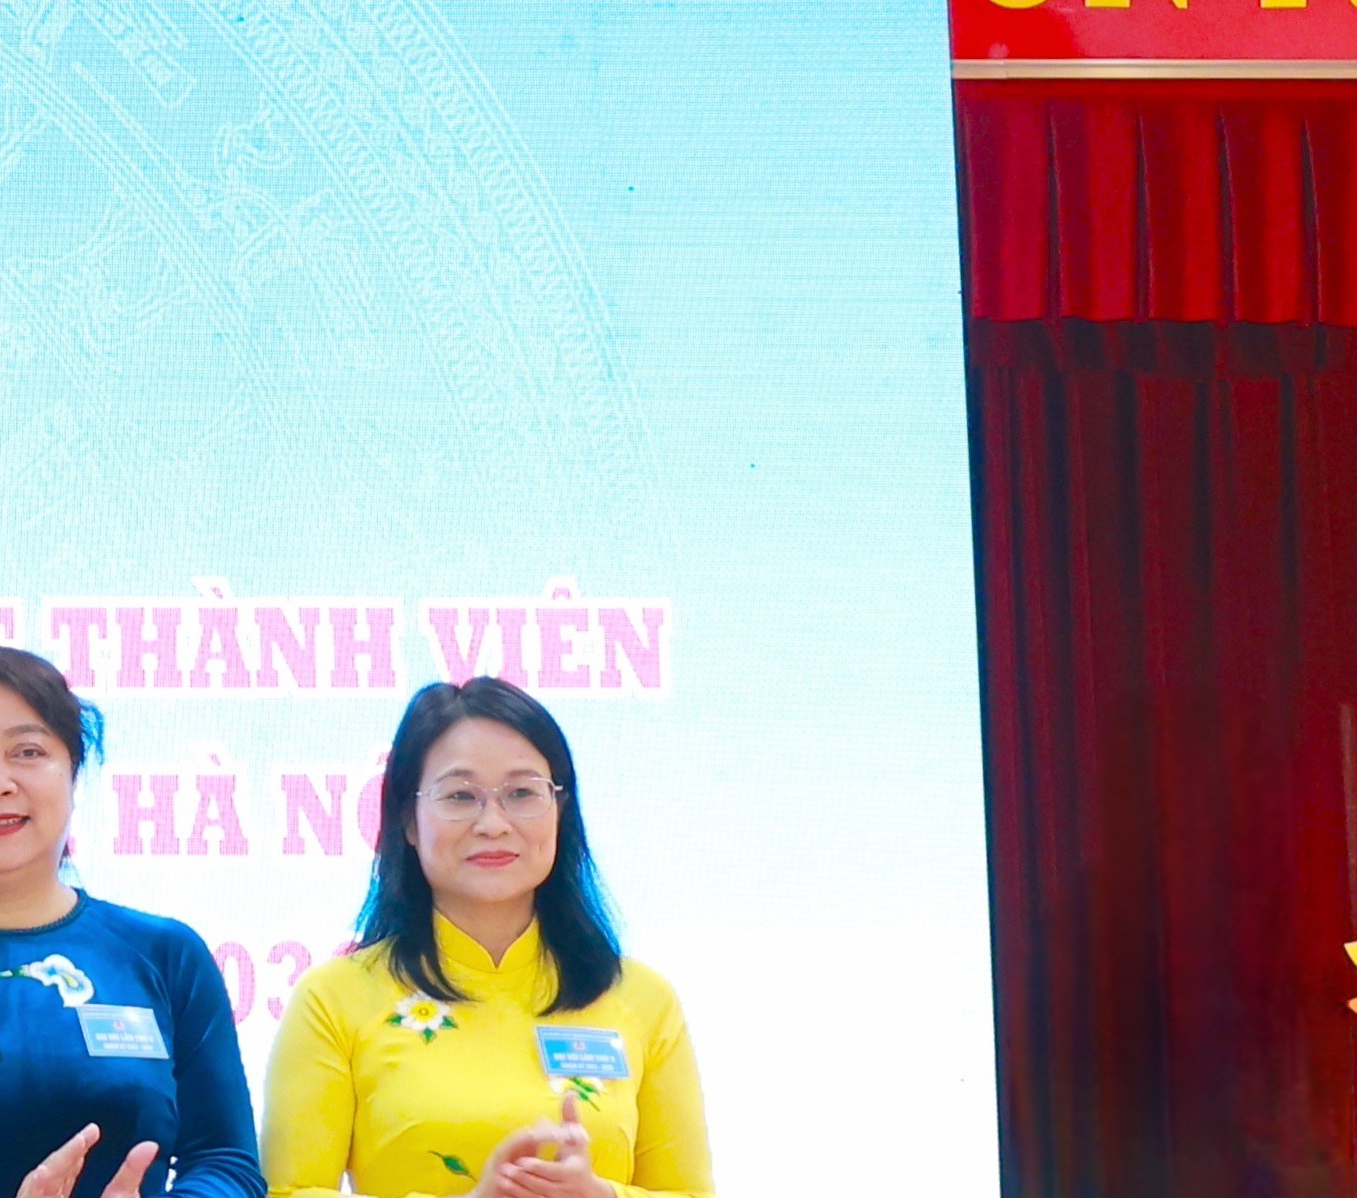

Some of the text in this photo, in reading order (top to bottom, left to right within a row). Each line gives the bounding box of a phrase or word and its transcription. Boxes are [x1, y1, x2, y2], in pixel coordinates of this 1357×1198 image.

[50, 586, 398, 689] THÀNH
[428, 586, 665, 689] VIÊN
[111, 752, 250, 856] HÀ
